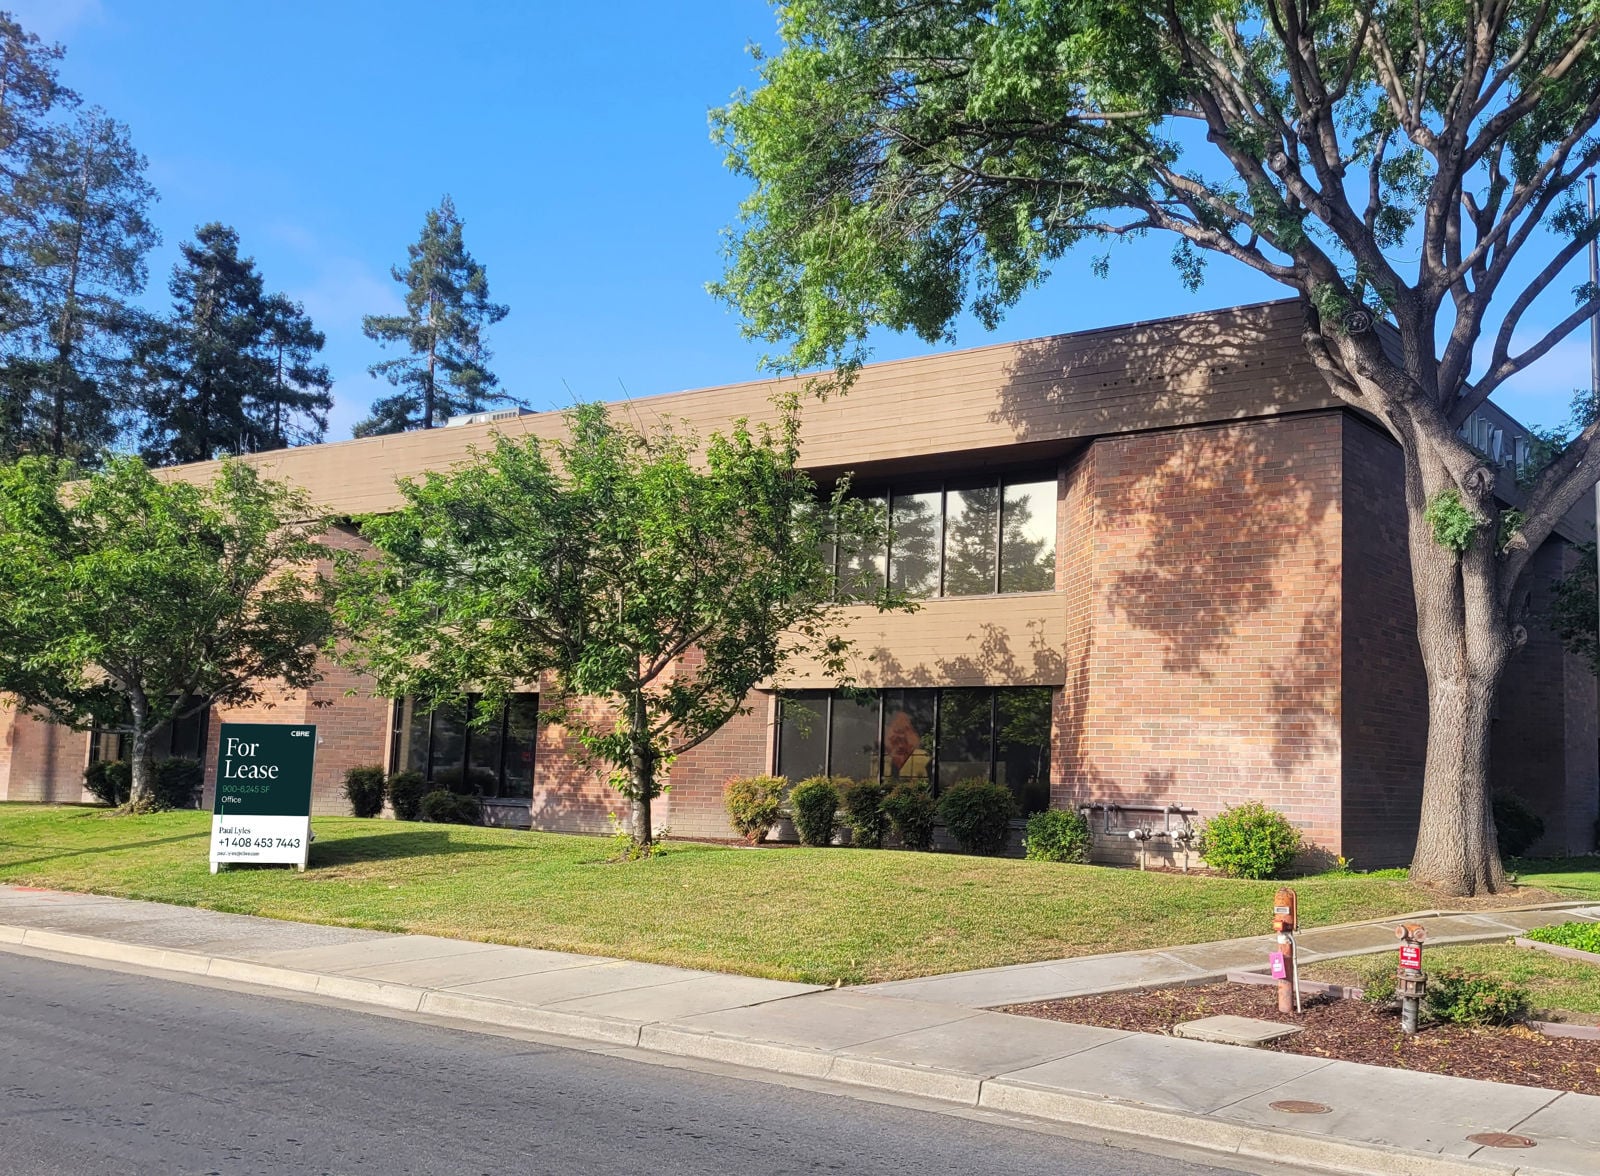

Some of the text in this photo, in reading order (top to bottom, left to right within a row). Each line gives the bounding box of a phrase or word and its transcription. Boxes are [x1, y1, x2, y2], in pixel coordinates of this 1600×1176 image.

[225, 737, 259, 757] For
[224, 759, 279, 779] Lease
[260, 785, 270, 793] SF
[221, 795, 242, 804] Office
[219, 826, 251, 836] Paul Lyles
[219, 837, 301, 848] +1 408 453 7443
